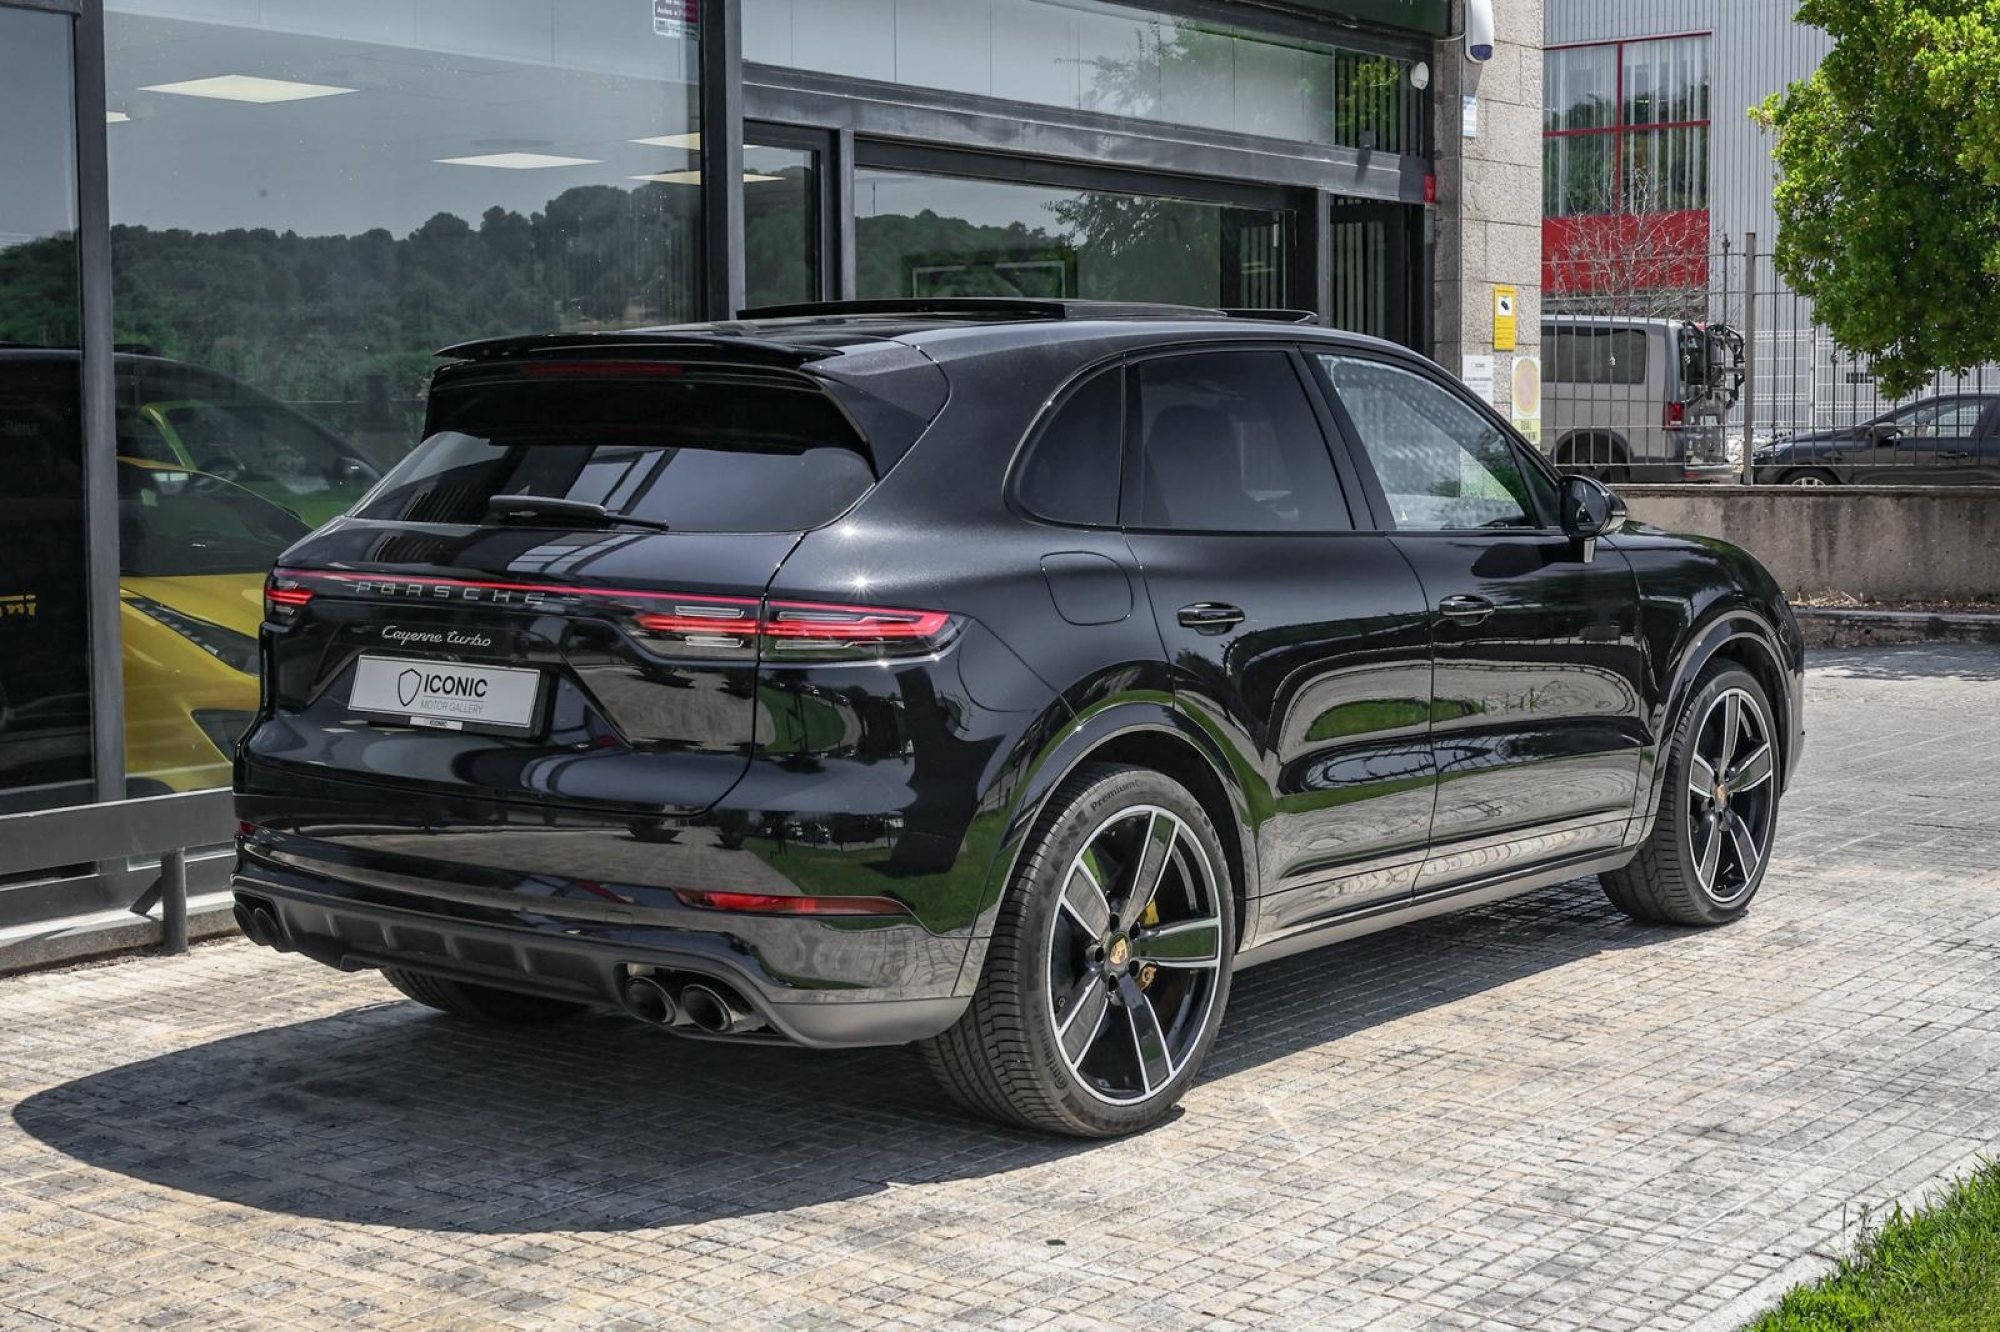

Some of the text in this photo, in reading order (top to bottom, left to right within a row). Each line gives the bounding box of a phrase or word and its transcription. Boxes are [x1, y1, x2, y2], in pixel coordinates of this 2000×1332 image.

[355, 581, 545, 605] PORSCHE
[381, 625, 443, 646] Cayenne
[423, 674, 489, 699] ICONIC
[420, 700, 448, 711] MOTOR
